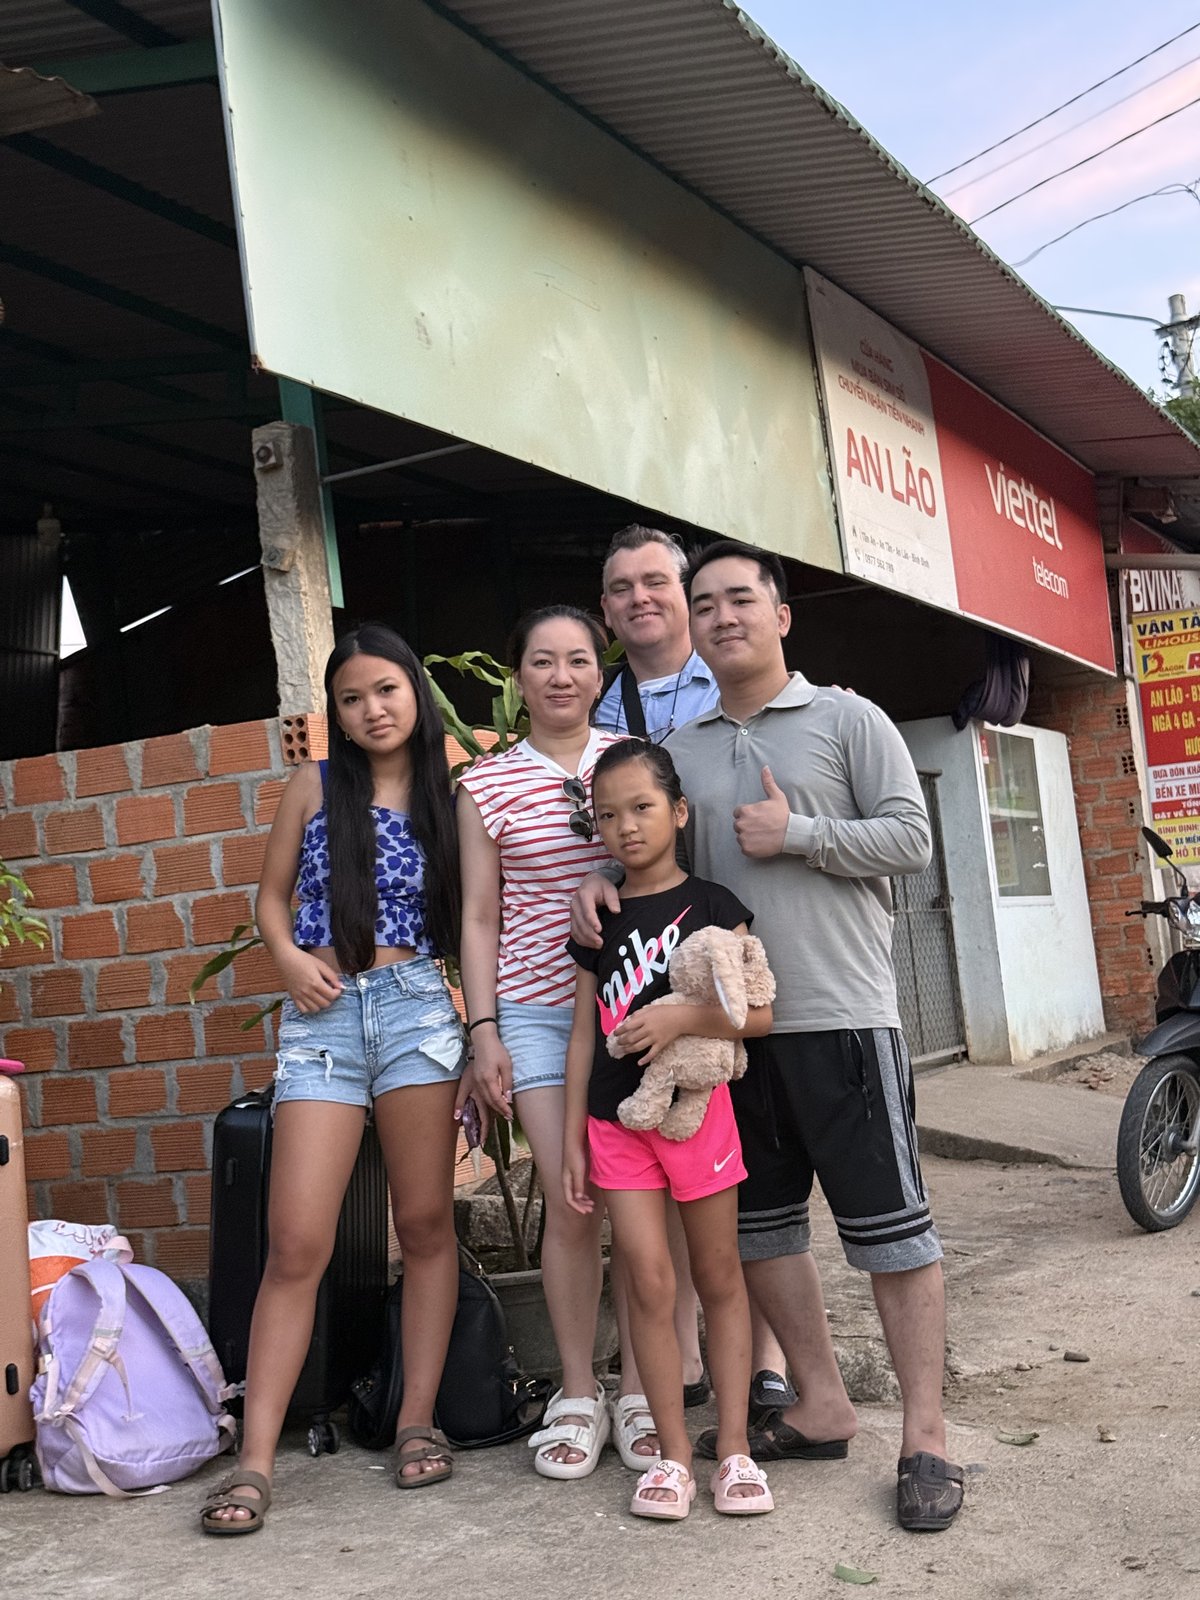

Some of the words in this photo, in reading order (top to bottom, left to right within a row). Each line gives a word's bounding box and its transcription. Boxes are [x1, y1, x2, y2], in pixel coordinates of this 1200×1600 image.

[847, 427, 884, 493] AN
[885, 446, 936, 518] LÃO
[1032, 556, 1069, 599] telecom
[1137, 619, 1174, 637] VẬN
[1150, 689, 1164, 707] AN
[1165, 685, 1183, 705] LÃO
[1152, 711, 1172, 733] NGÃ
[1173, 713, 1180, 730] 4
[1182, 711, 1195, 729] GA
[1155, 783, 1173, 799] BẾN
[1175, 784, 1187, 797] XE
[603, 924, 680, 1019] nike
